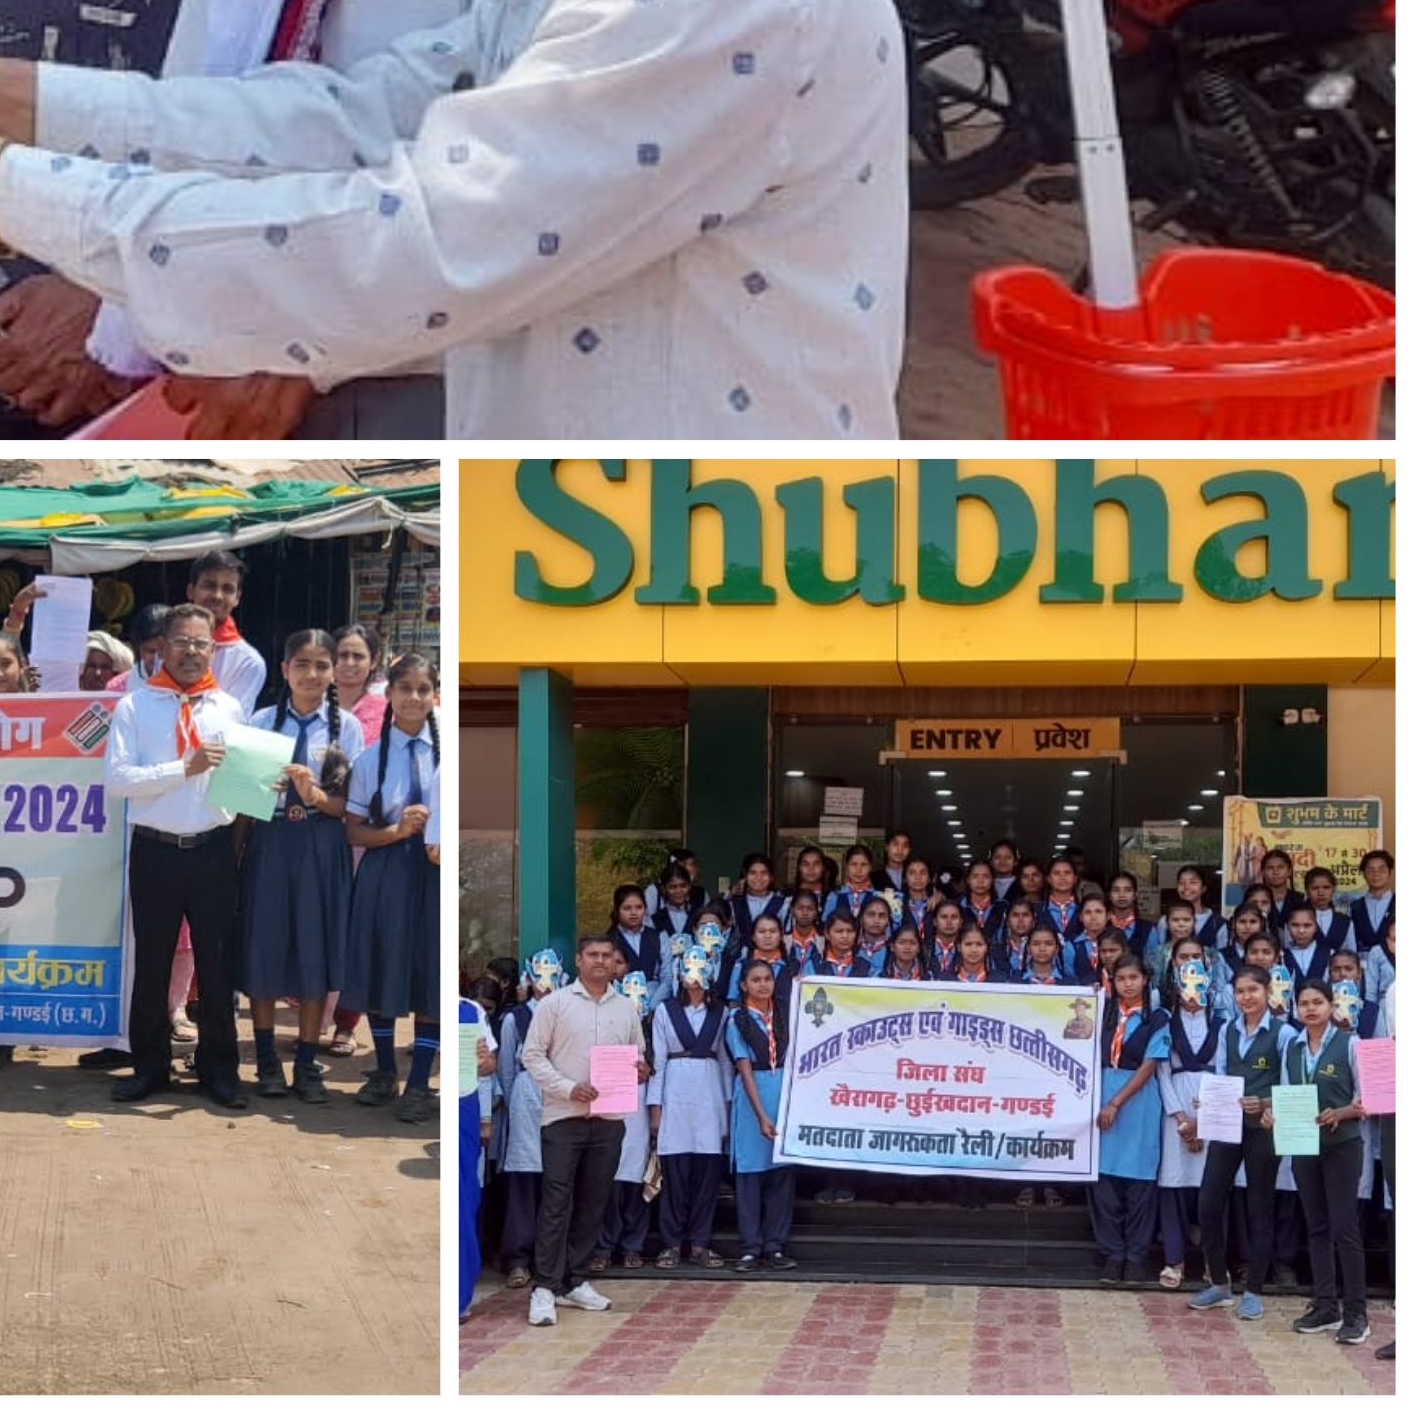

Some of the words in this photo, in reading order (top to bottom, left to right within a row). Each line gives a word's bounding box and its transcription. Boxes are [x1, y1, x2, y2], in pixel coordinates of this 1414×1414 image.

[910, 729, 1002, 750] ENTRY
[1033, 723, 1092, 751] प्रवेश
[4, 784, 107, 833] 2024
[1286, 805, 1320, 825] शुभम
[1324, 803, 1339, 821] के
[1343, 803, 1369, 821] मार्ट
[1325, 848, 1338, 858] 17
[1351, 848, 1366, 858] 30
[798, 1031, 843, 1074] भारत
[847, 1012, 915, 1050] स्काउट्स
[919, 1003, 947, 1035] एवं
[948, 1011, 1006, 1048] गाइड्स
[1009, 1024, 1088, 1093] छत्तीसगढ़
[897, 1057, 947, 1082] जिला
[953, 1060, 986, 1084] संघ
[798, 1125, 865, 1149] मतदाता
